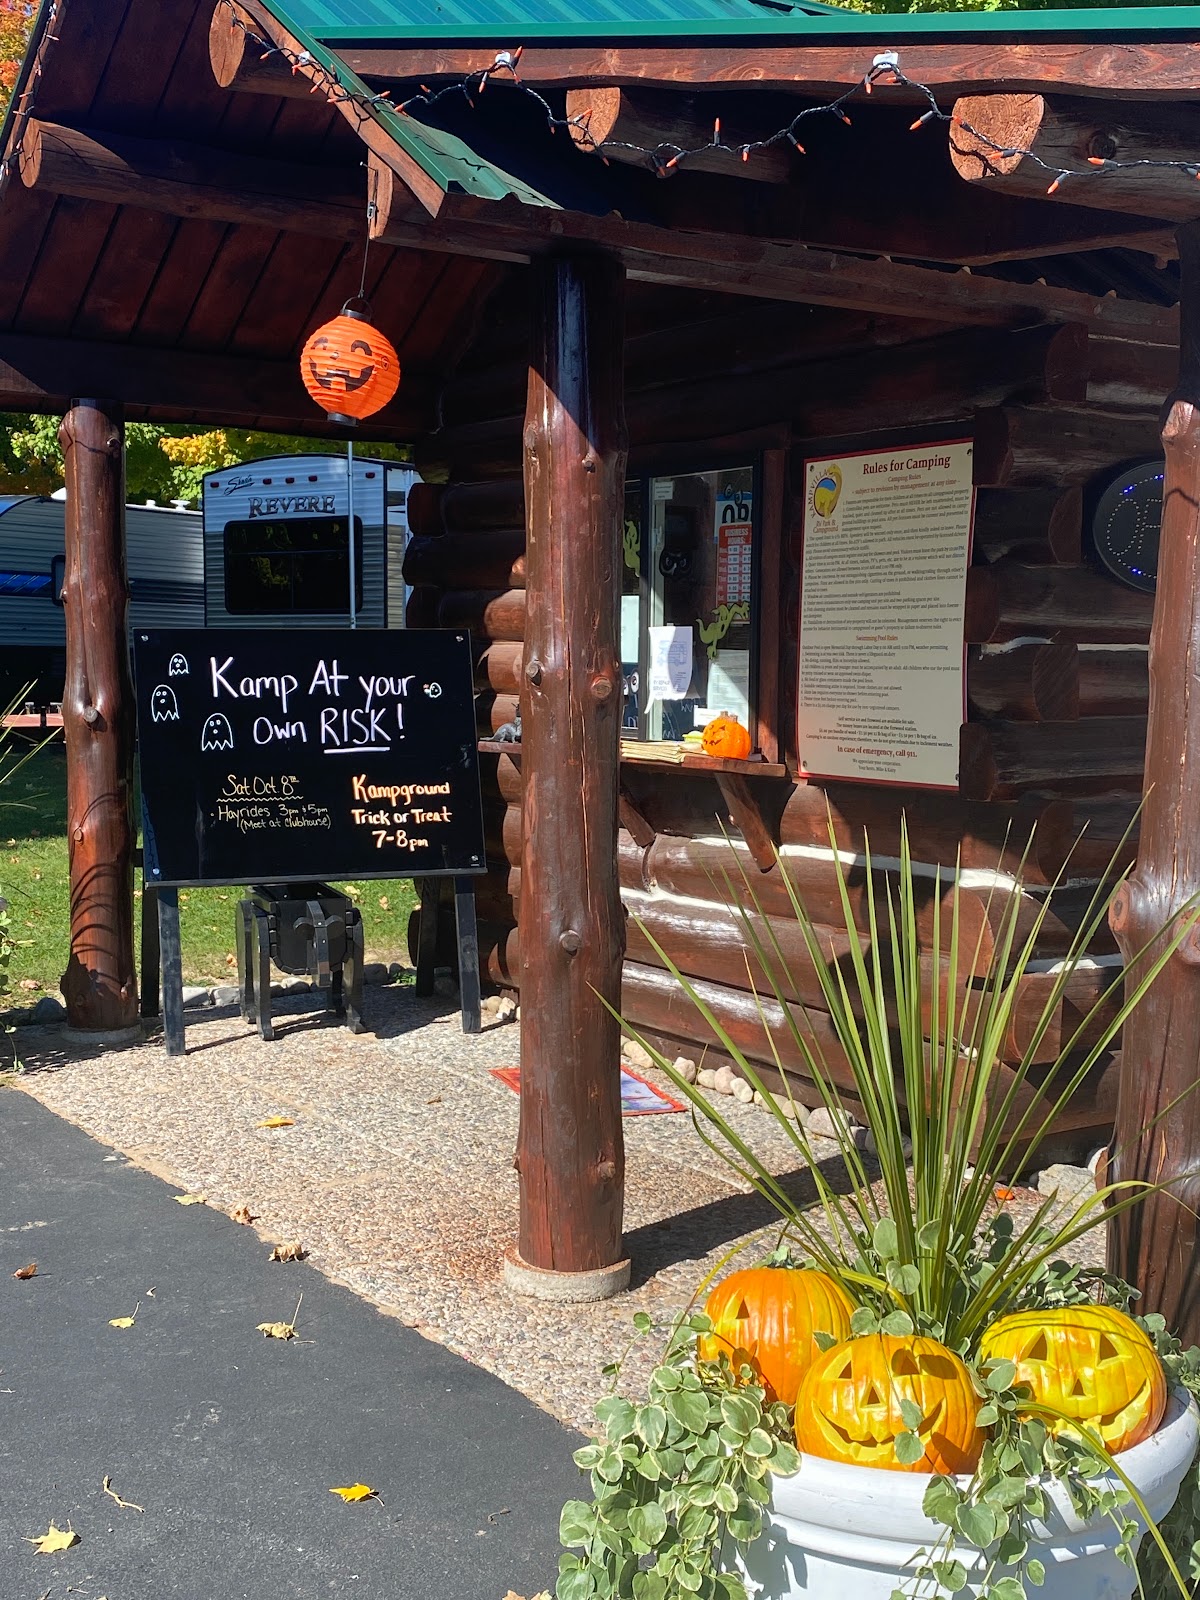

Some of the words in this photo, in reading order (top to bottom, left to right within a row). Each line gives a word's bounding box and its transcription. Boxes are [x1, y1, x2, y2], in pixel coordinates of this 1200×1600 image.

[863, 462, 887, 474] Rules
[890, 460, 904, 471] for
[906, 454, 951, 470] Camping
[248, 494, 336, 518] REVERE
[210, 657, 298, 713] Kamp
[308, 659, 349, 696] At
[359, 675, 416, 713] your
[253, 717, 307, 744] Own
[863, 747, 895, 758] emergency,
[352, 774, 450, 807] Kampground
[218, 805, 270, 828] Hayrides
[278, 804, 299, 818] 3pm
[308, 803, 328, 816] 5pm
[269, 818, 281, 828] at
[351, 809, 391, 825] Trick
[393, 813, 409, 823] or
[410, 806, 452, 824] Treat
[372, 830, 429, 852] 7-8pm
